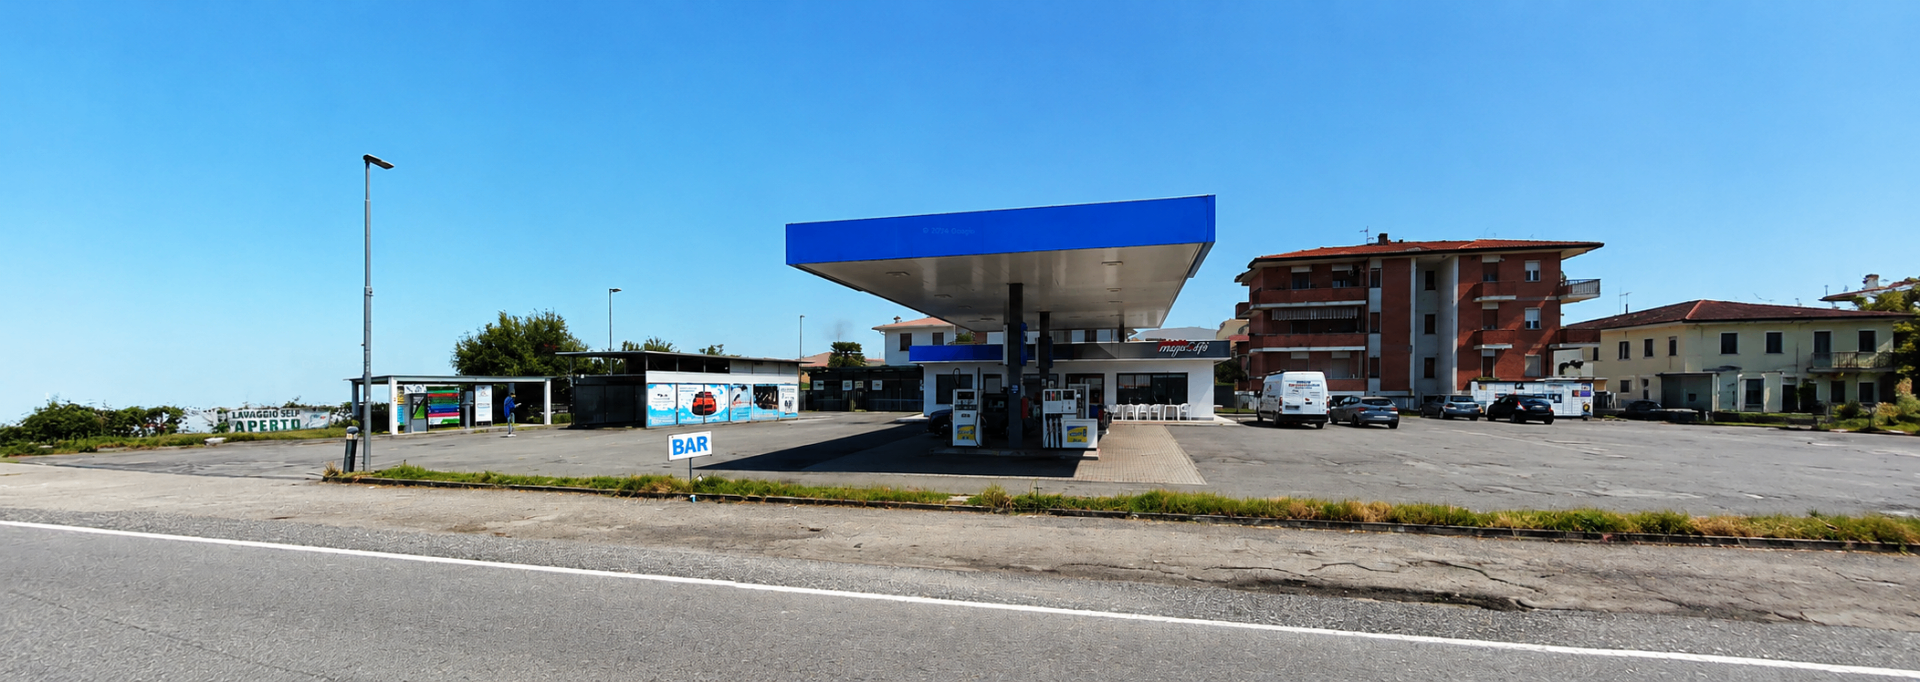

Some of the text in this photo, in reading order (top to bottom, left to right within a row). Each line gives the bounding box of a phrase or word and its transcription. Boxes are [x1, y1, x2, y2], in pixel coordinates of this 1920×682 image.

[232, 410, 278, 419] LAVAGGIO
[234, 418, 301, 433] APERTO
[672, 435, 708, 455] BAR
